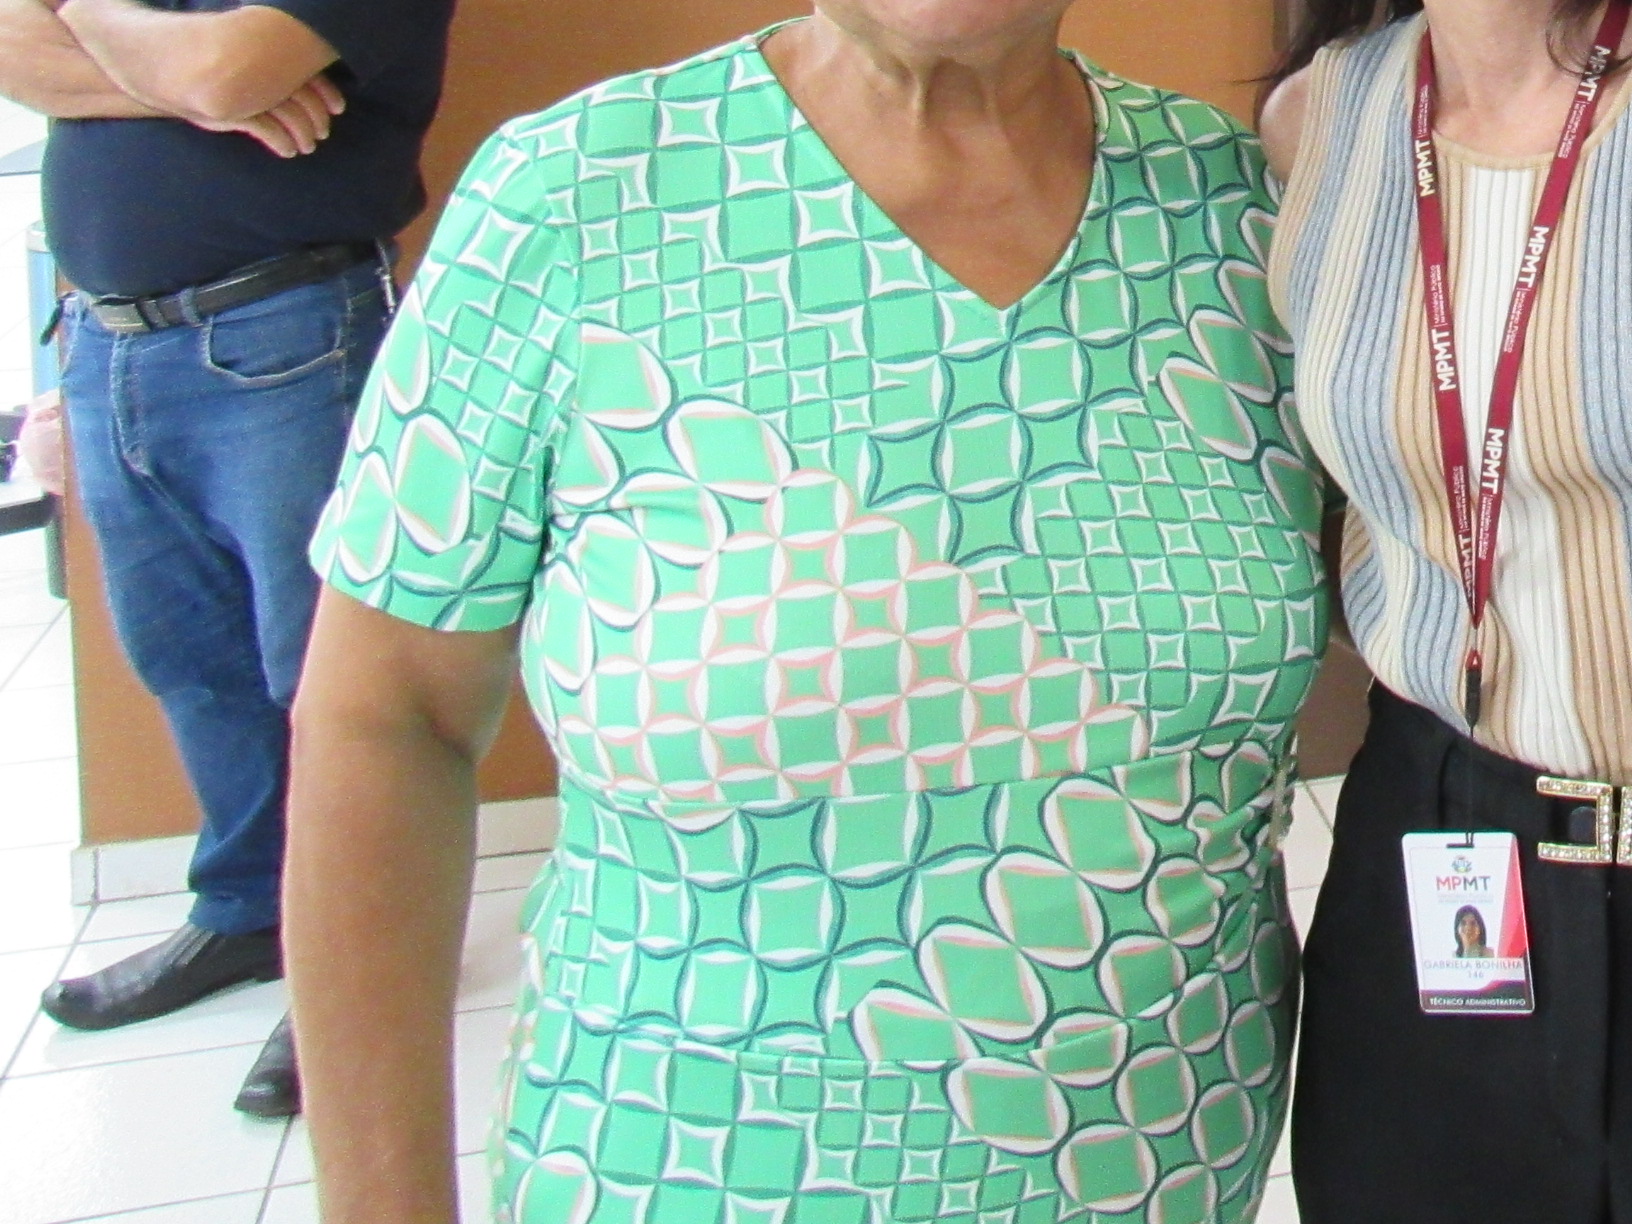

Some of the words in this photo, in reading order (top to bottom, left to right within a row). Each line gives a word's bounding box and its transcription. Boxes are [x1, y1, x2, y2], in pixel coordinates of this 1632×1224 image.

[1414, 140, 1434, 196] MPMT
[1518, 226, 1550, 287] MPMT
[1431, 329, 1456, 390] MPMT
[1482, 428, 1504, 494] MPMT
[1436, 876, 1491, 891] MPMT
[1424, 960, 1472, 970] GABRIELA
